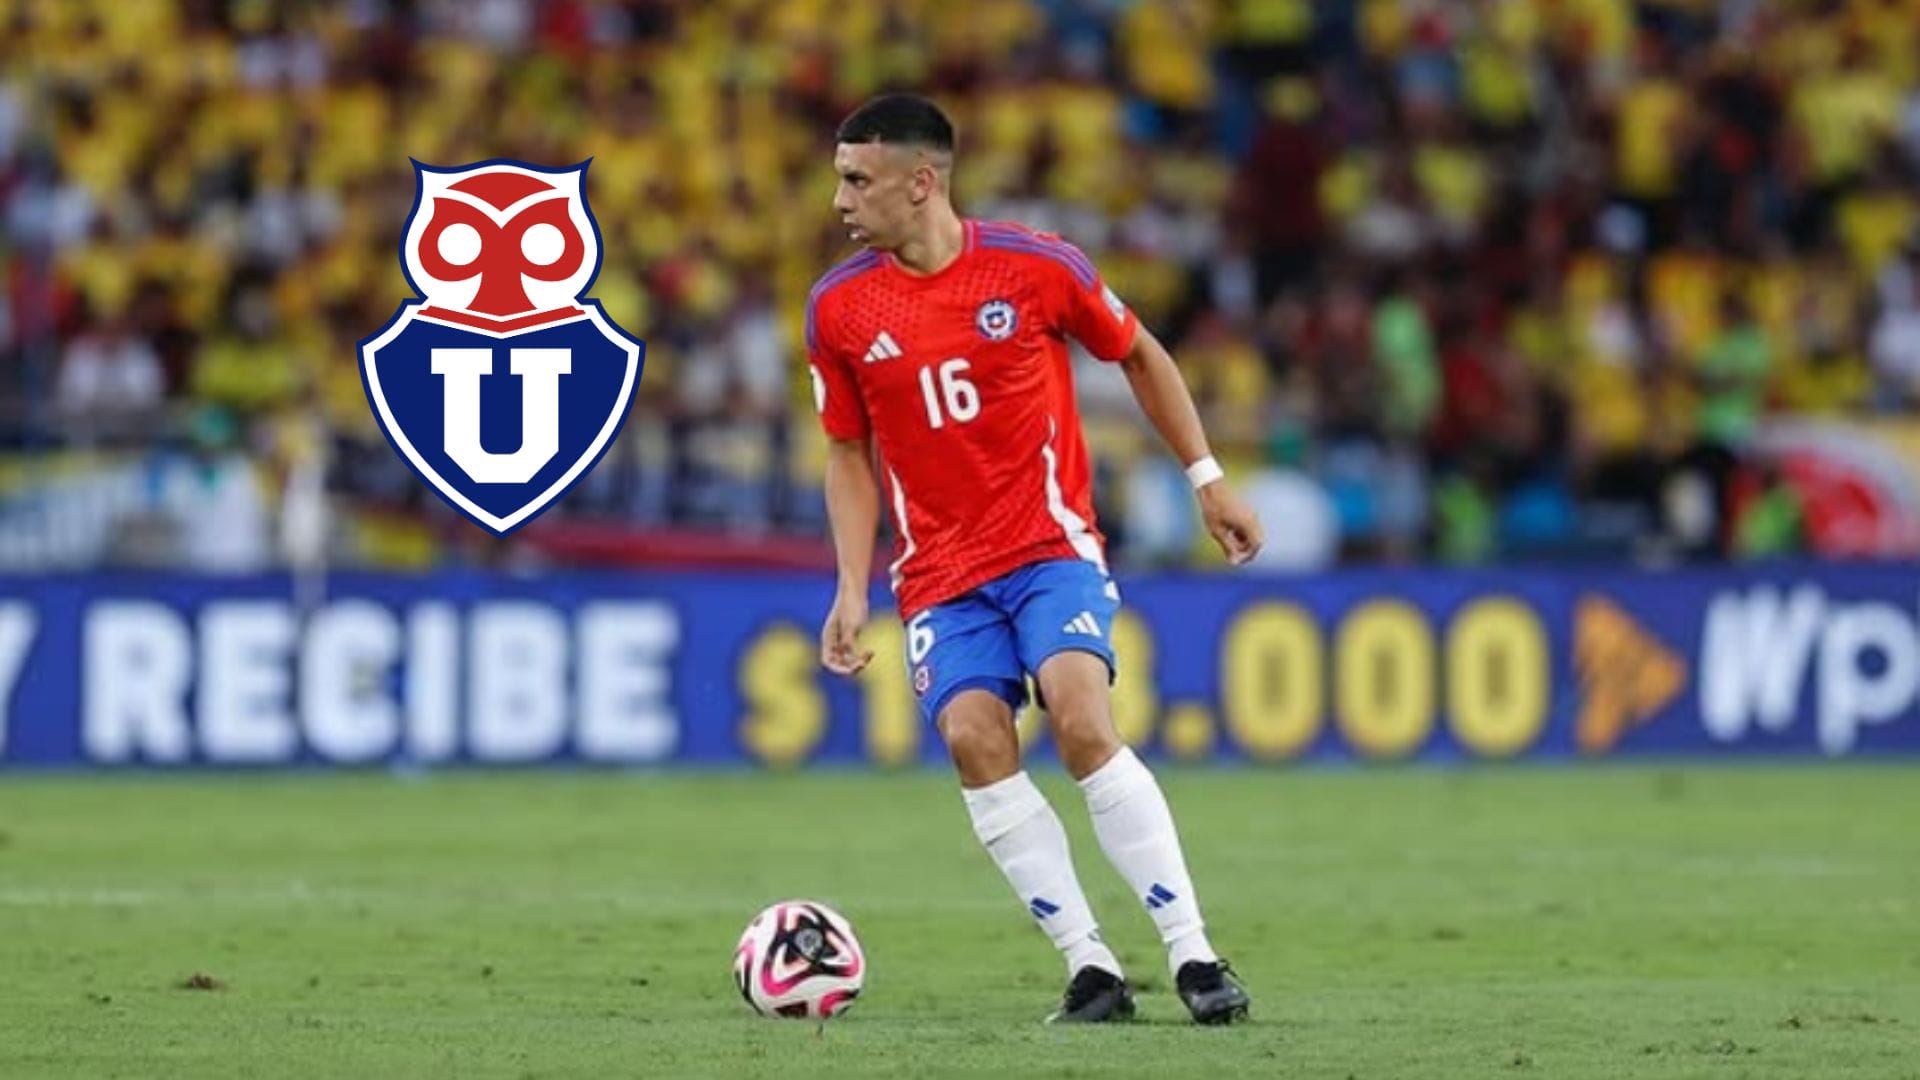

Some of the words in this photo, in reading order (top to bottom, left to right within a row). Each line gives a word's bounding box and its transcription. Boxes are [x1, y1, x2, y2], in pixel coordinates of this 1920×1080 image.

[918, 358, 981, 429] 16
[82, 602, 679, 760] RECIBE
[740, 600, 1549, 762] $1.000
